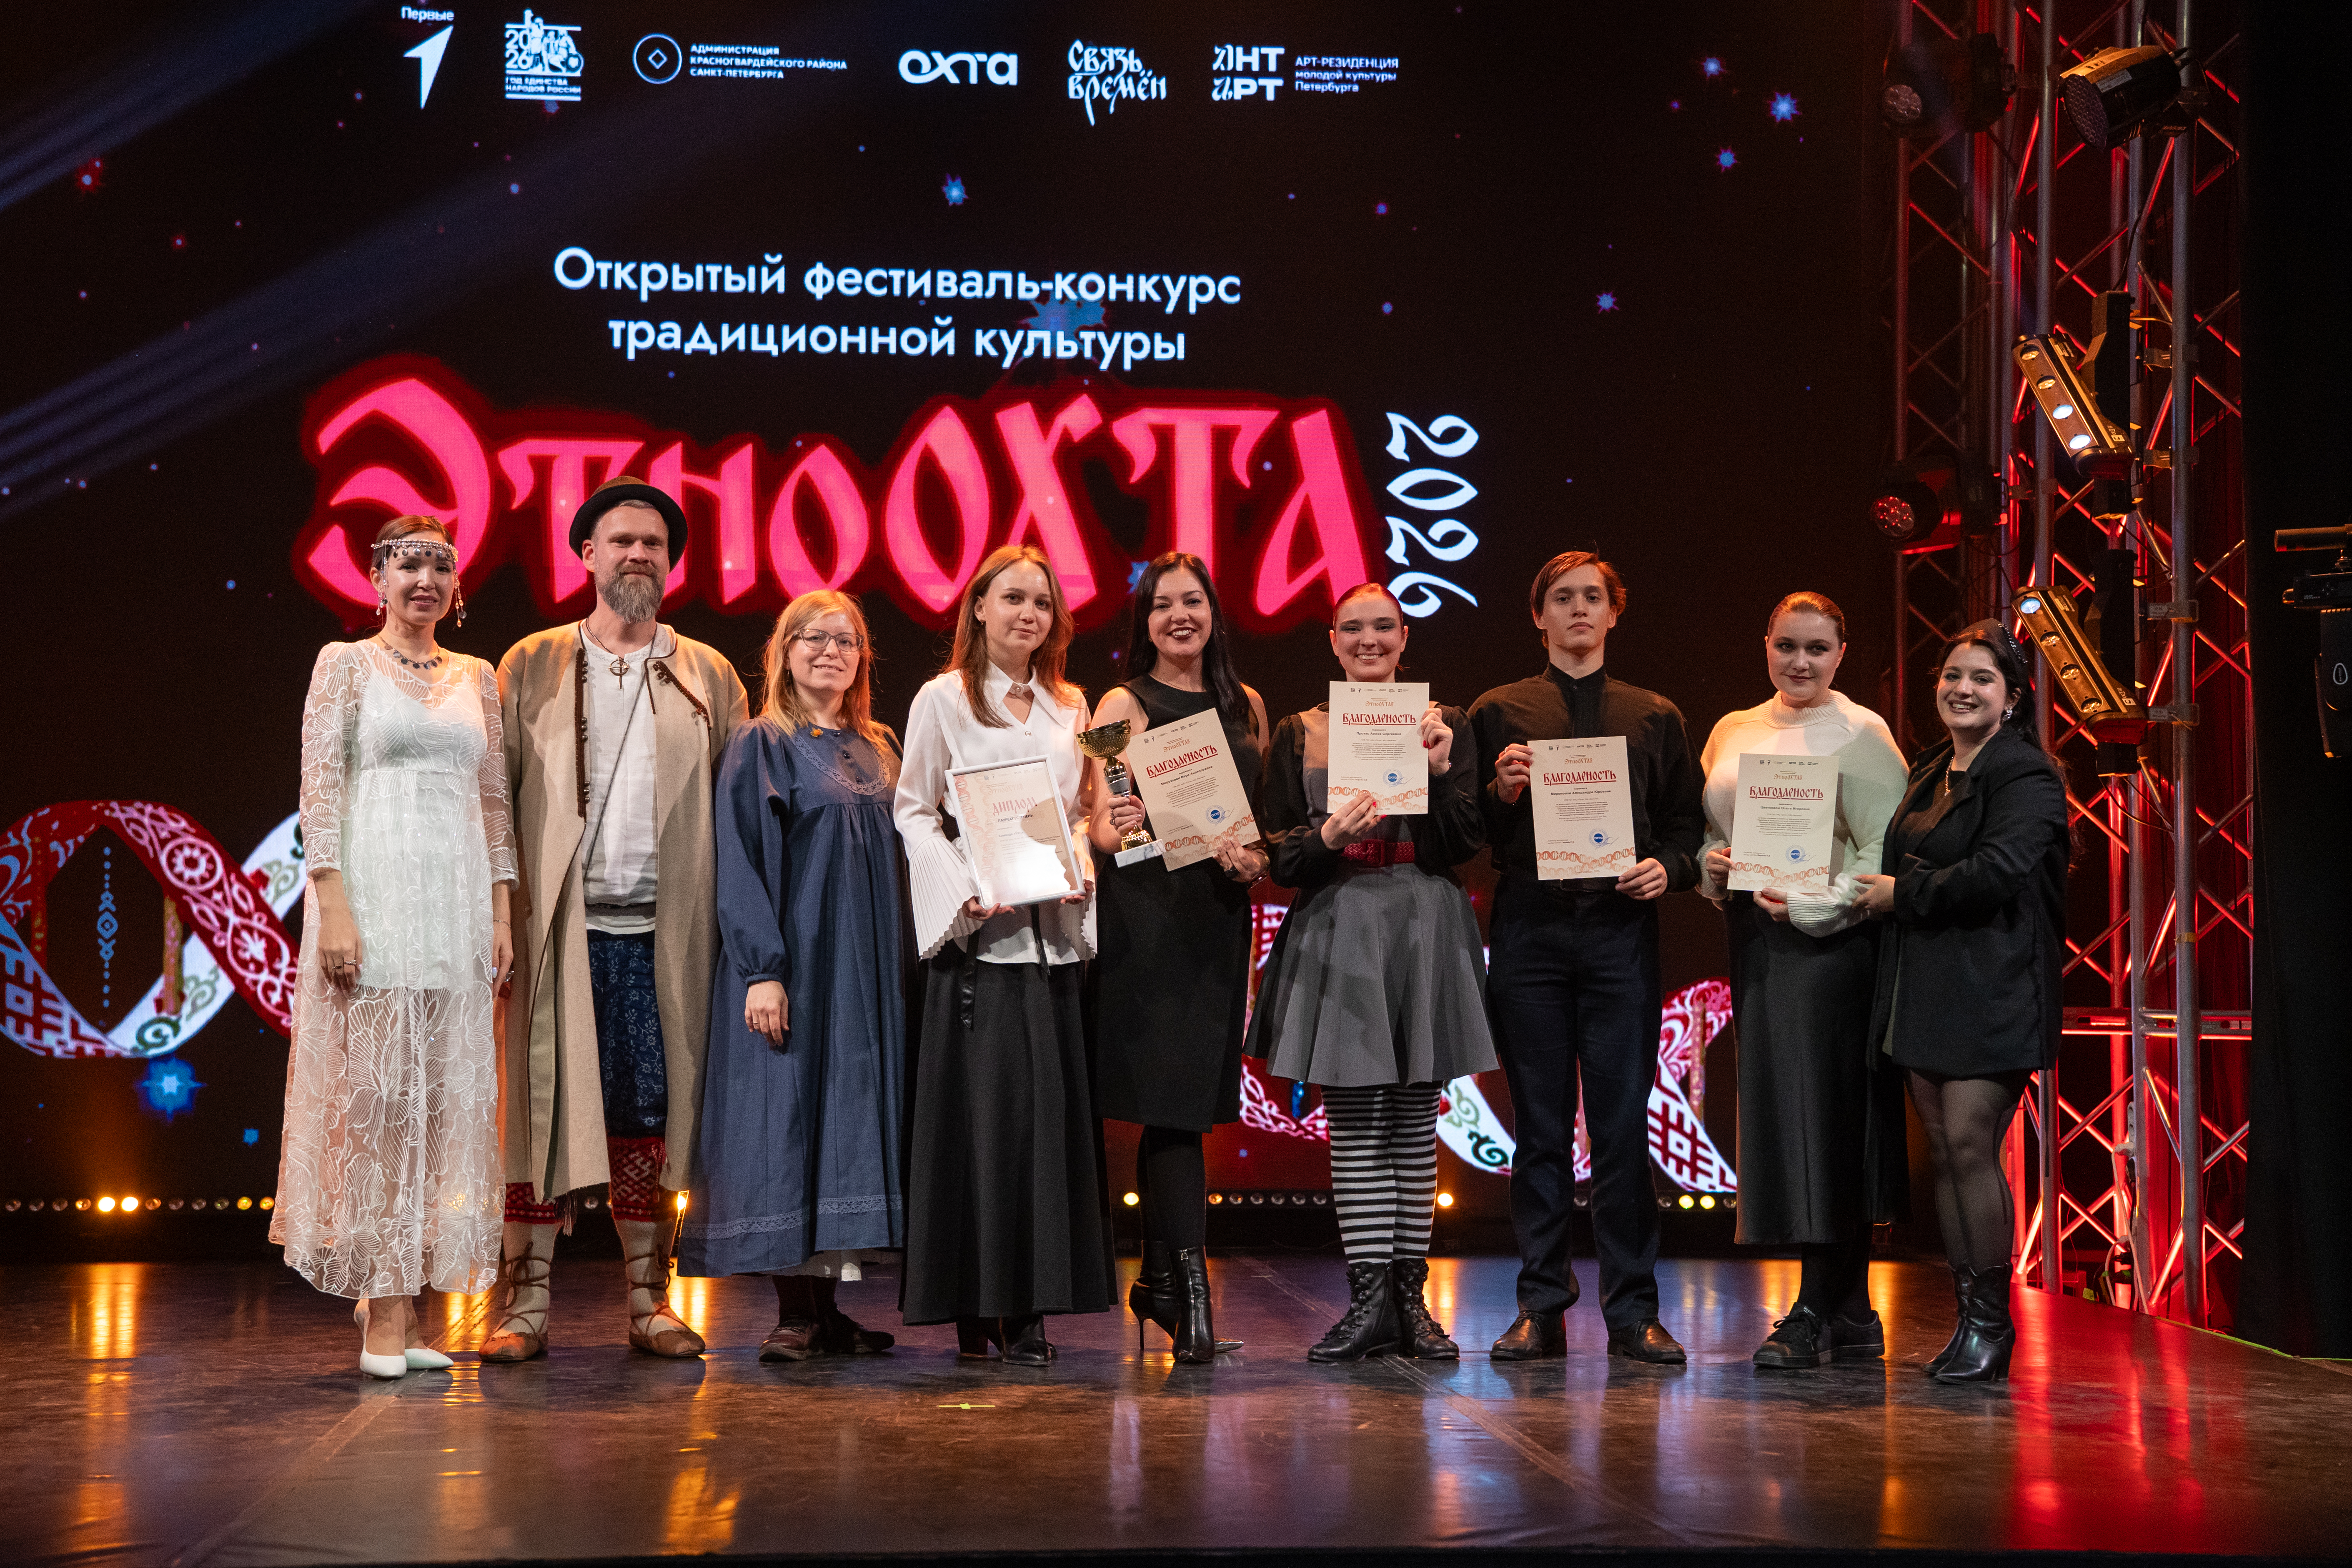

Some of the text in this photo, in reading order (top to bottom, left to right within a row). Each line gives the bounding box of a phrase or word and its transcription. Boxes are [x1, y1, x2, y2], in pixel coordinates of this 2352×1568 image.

[401, 6, 454, 22] Первые
[691, 44, 779, 56] АДМИНИСТРАЦИЯ
[690, 56, 848, 70] КРАСНОГВАРДЕЙСКОГО РАЙОНА
[1068, 39, 1143, 87] Связь
[1295, 56, 1399, 70] АРТ-РЕЗИДЕНЦИЯ
[690, 68, 784, 79] САНКТ-ПЕТЕРБУРГА
[1295, 70, 1397, 83] молодой культуры
[1295, 80, 1359, 94] Петербурга
[1068, 68, 1167, 126] времён
[554, 247, 1240, 314] Открытый фестиваль-конкурс
[609, 316, 1185, 371] традиционной культуры
[1385, 412, 1479, 619] 2026
[1343, 713, 1416, 726] БЛАГОДАРНОСТЬ
[1147, 745, 1217, 778] БЛАГОДАРНОСТЬ
[1161, 776, 1180, 786] Морозовой
[1190, 765, 1213, 775] Анатольевне
[1543, 770, 1617, 786] БЛАГОДАРНОСТЬ
[1750, 786, 1823, 799] БЛАГОДАРНОСТЬ
[992, 797, 1037, 816] ДИПЛОМ
